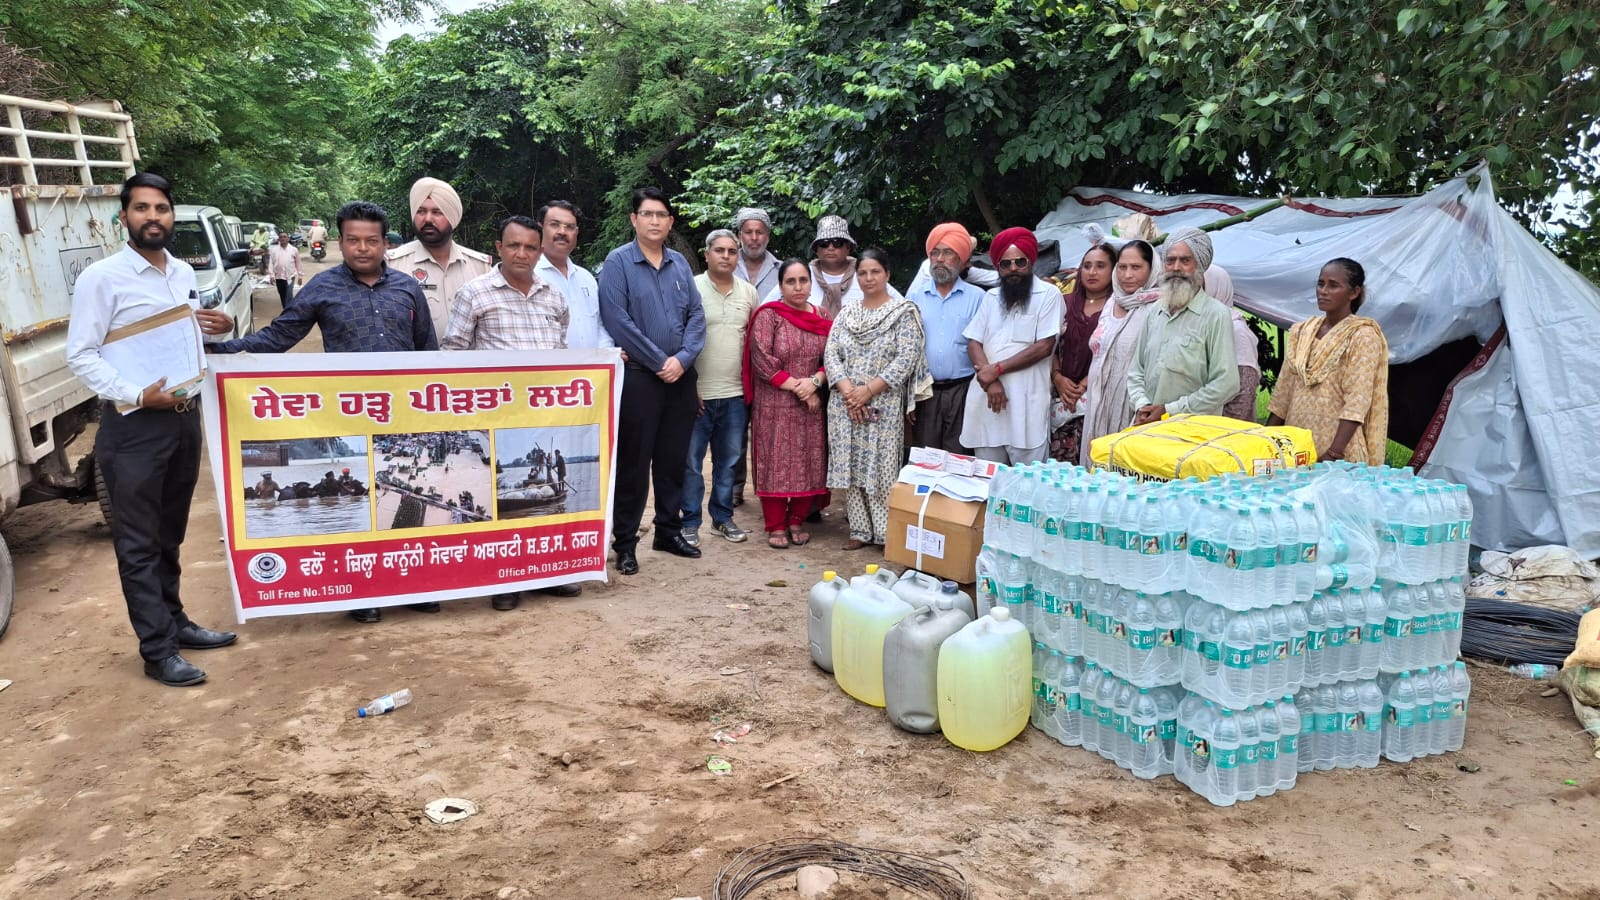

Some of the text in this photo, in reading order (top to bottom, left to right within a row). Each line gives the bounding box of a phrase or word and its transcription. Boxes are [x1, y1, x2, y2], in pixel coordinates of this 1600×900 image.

[251, 378, 593, 423] ਸੇਵਾ ਹੜ੍ਹ ਪੀੜਤਾਂ ਲਈ
[430, 540, 468, 565] ਸੇਵਾਵਾਂ
[473, 533, 522, 560] ਅਥਾਰਟੀ
[571, 530, 599, 549] ਨਗਰ
[498, 567, 526, 578] Office
[257, 590, 275, 600] Toll
[278, 588, 300, 599] Free
